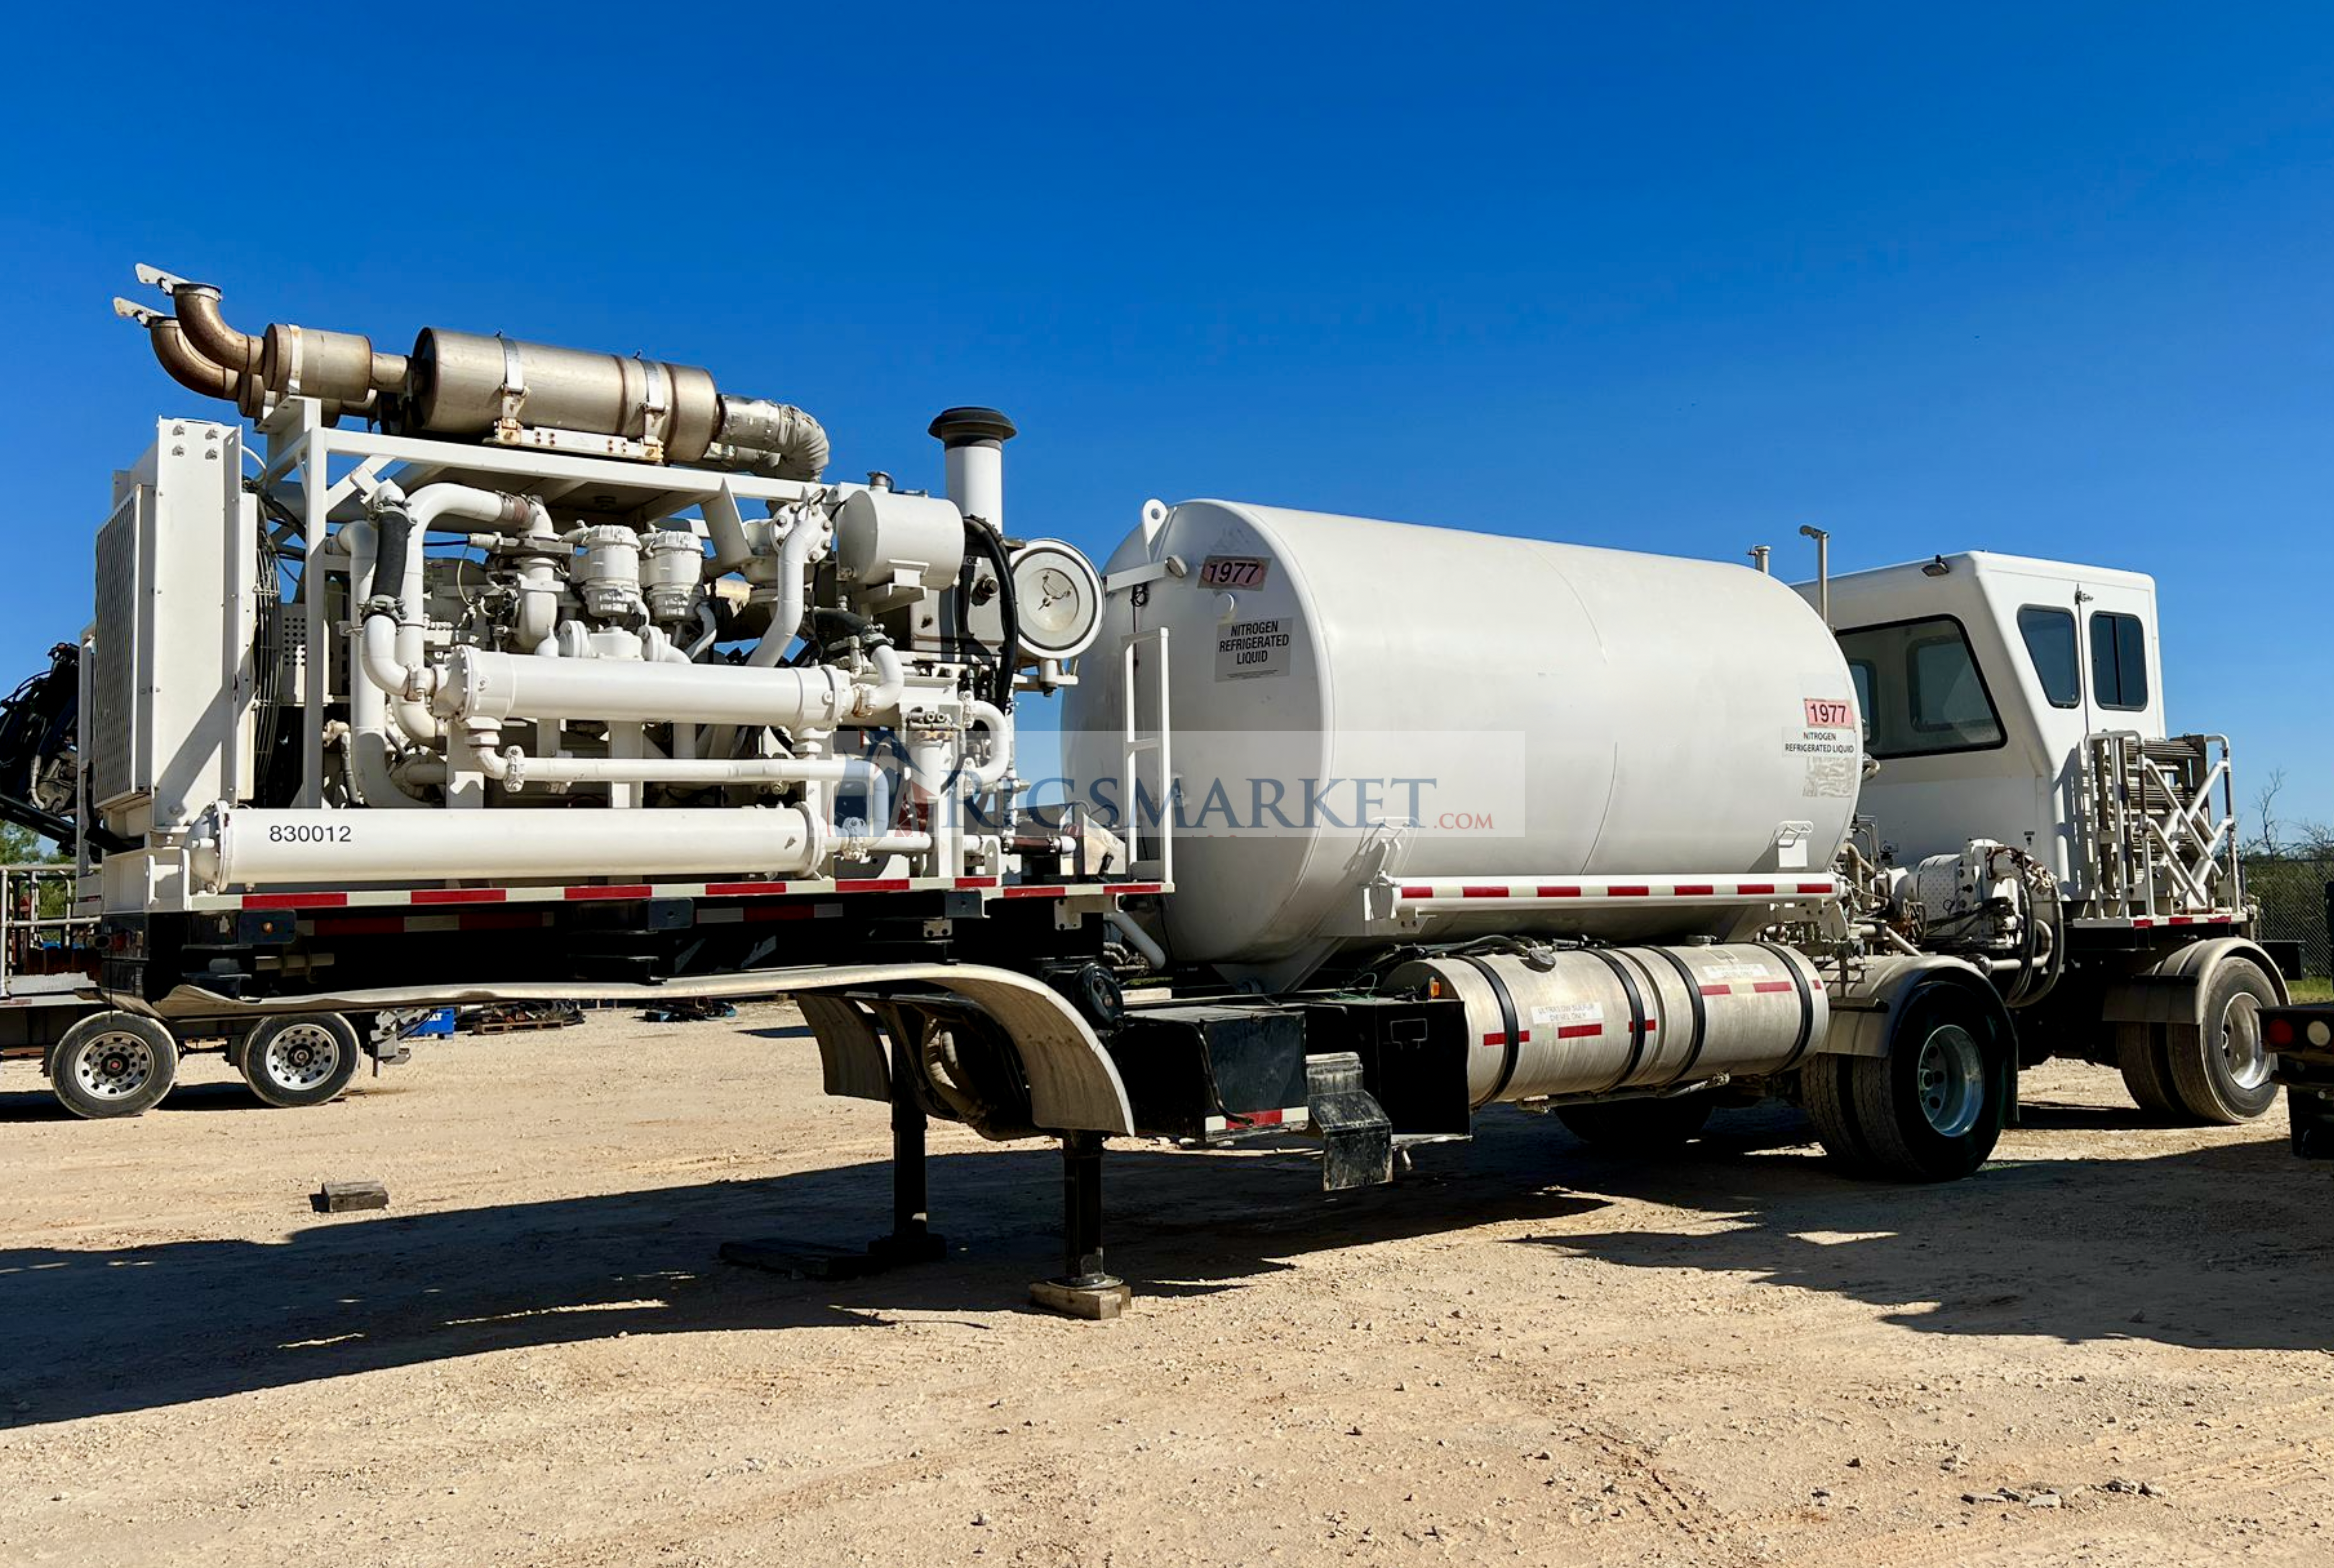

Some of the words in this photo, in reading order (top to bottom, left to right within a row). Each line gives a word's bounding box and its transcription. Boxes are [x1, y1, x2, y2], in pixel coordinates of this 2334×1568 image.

[1209, 562, 1259, 584] 1977
[1230, 620, 1279, 637] NITROGEN
[1219, 634, 1290, 653] REFRIGERATED
[1236, 650, 1268, 665] LIQUID
[1810, 703, 1846, 723] 1977
[1803, 731, 1836, 741] NITROGEN
[1785, 743, 1832, 753] REFRIGERATED
[1832, 744, 1855, 754] LIQUID
[269, 825, 352, 842] 830012
